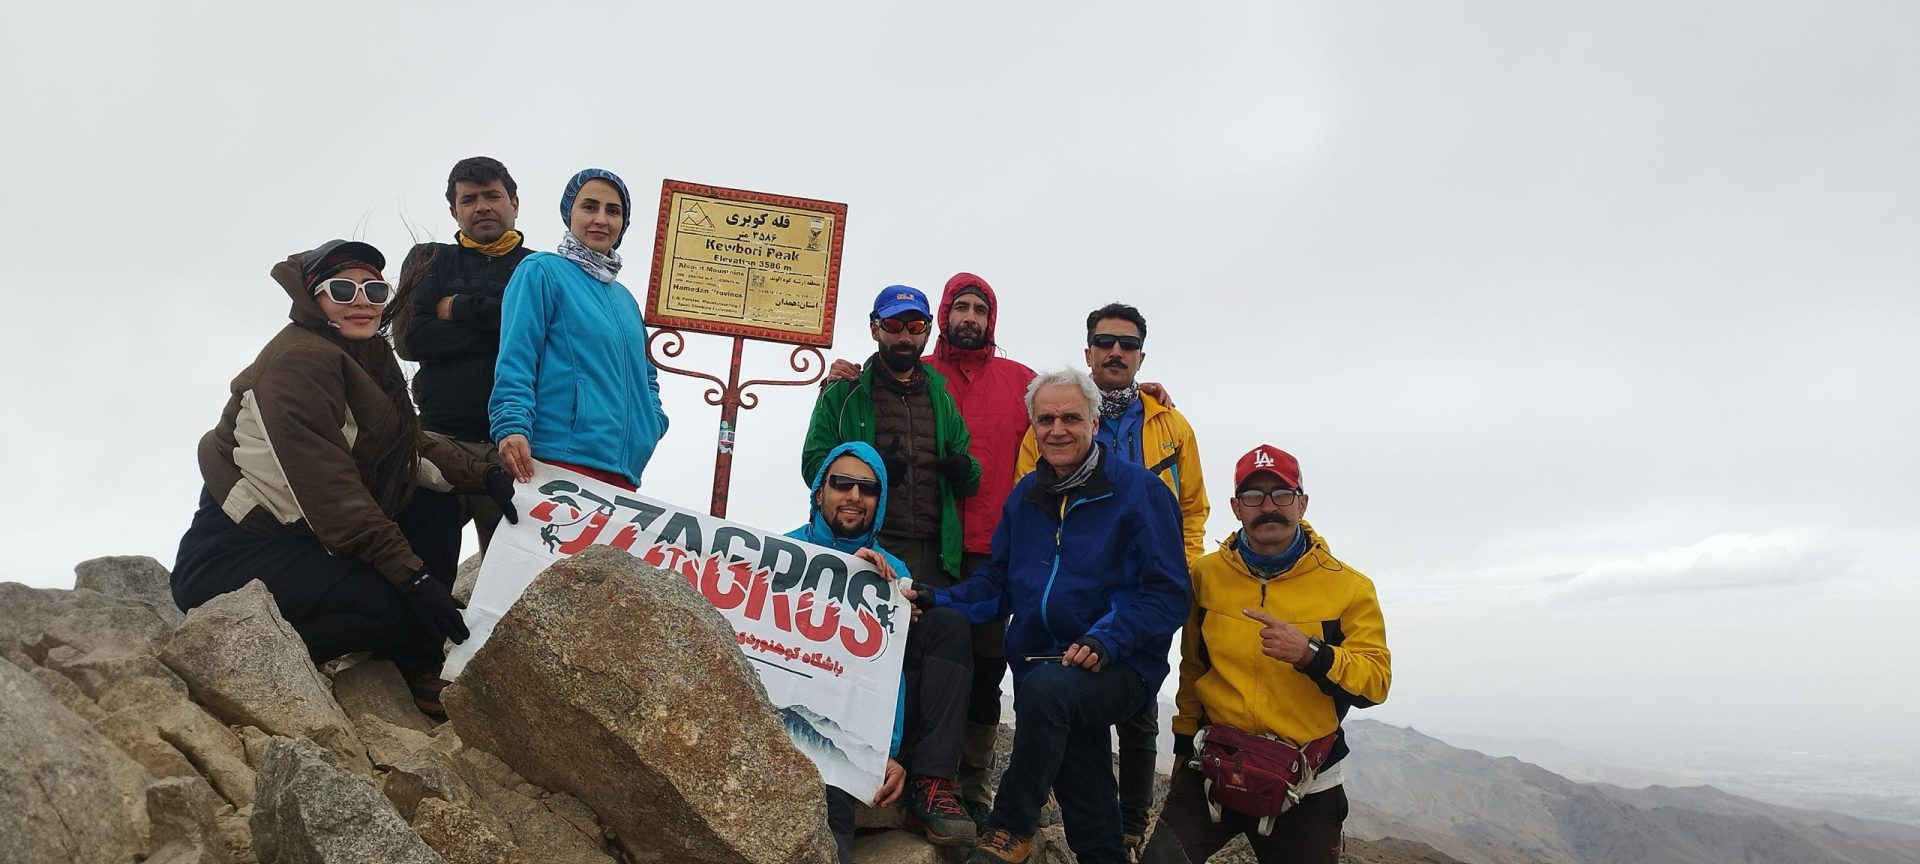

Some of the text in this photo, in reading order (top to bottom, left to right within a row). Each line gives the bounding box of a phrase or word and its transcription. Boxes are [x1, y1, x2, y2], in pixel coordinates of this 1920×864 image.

[726, 213, 768, 228] کوبری
[772, 214, 790, 228] قله
[753, 232, 777, 242] ۳۵۸۶
[706, 239, 800, 261] Kewbori Peak
[759, 261, 780, 270] 3586
[673, 284, 708, 294] Hamedan
[1254, 449, 1274, 468] LA
[608, 494, 890, 658] ZAGROS
[736, 632, 844, 677] باشگاه کوهنوردی
